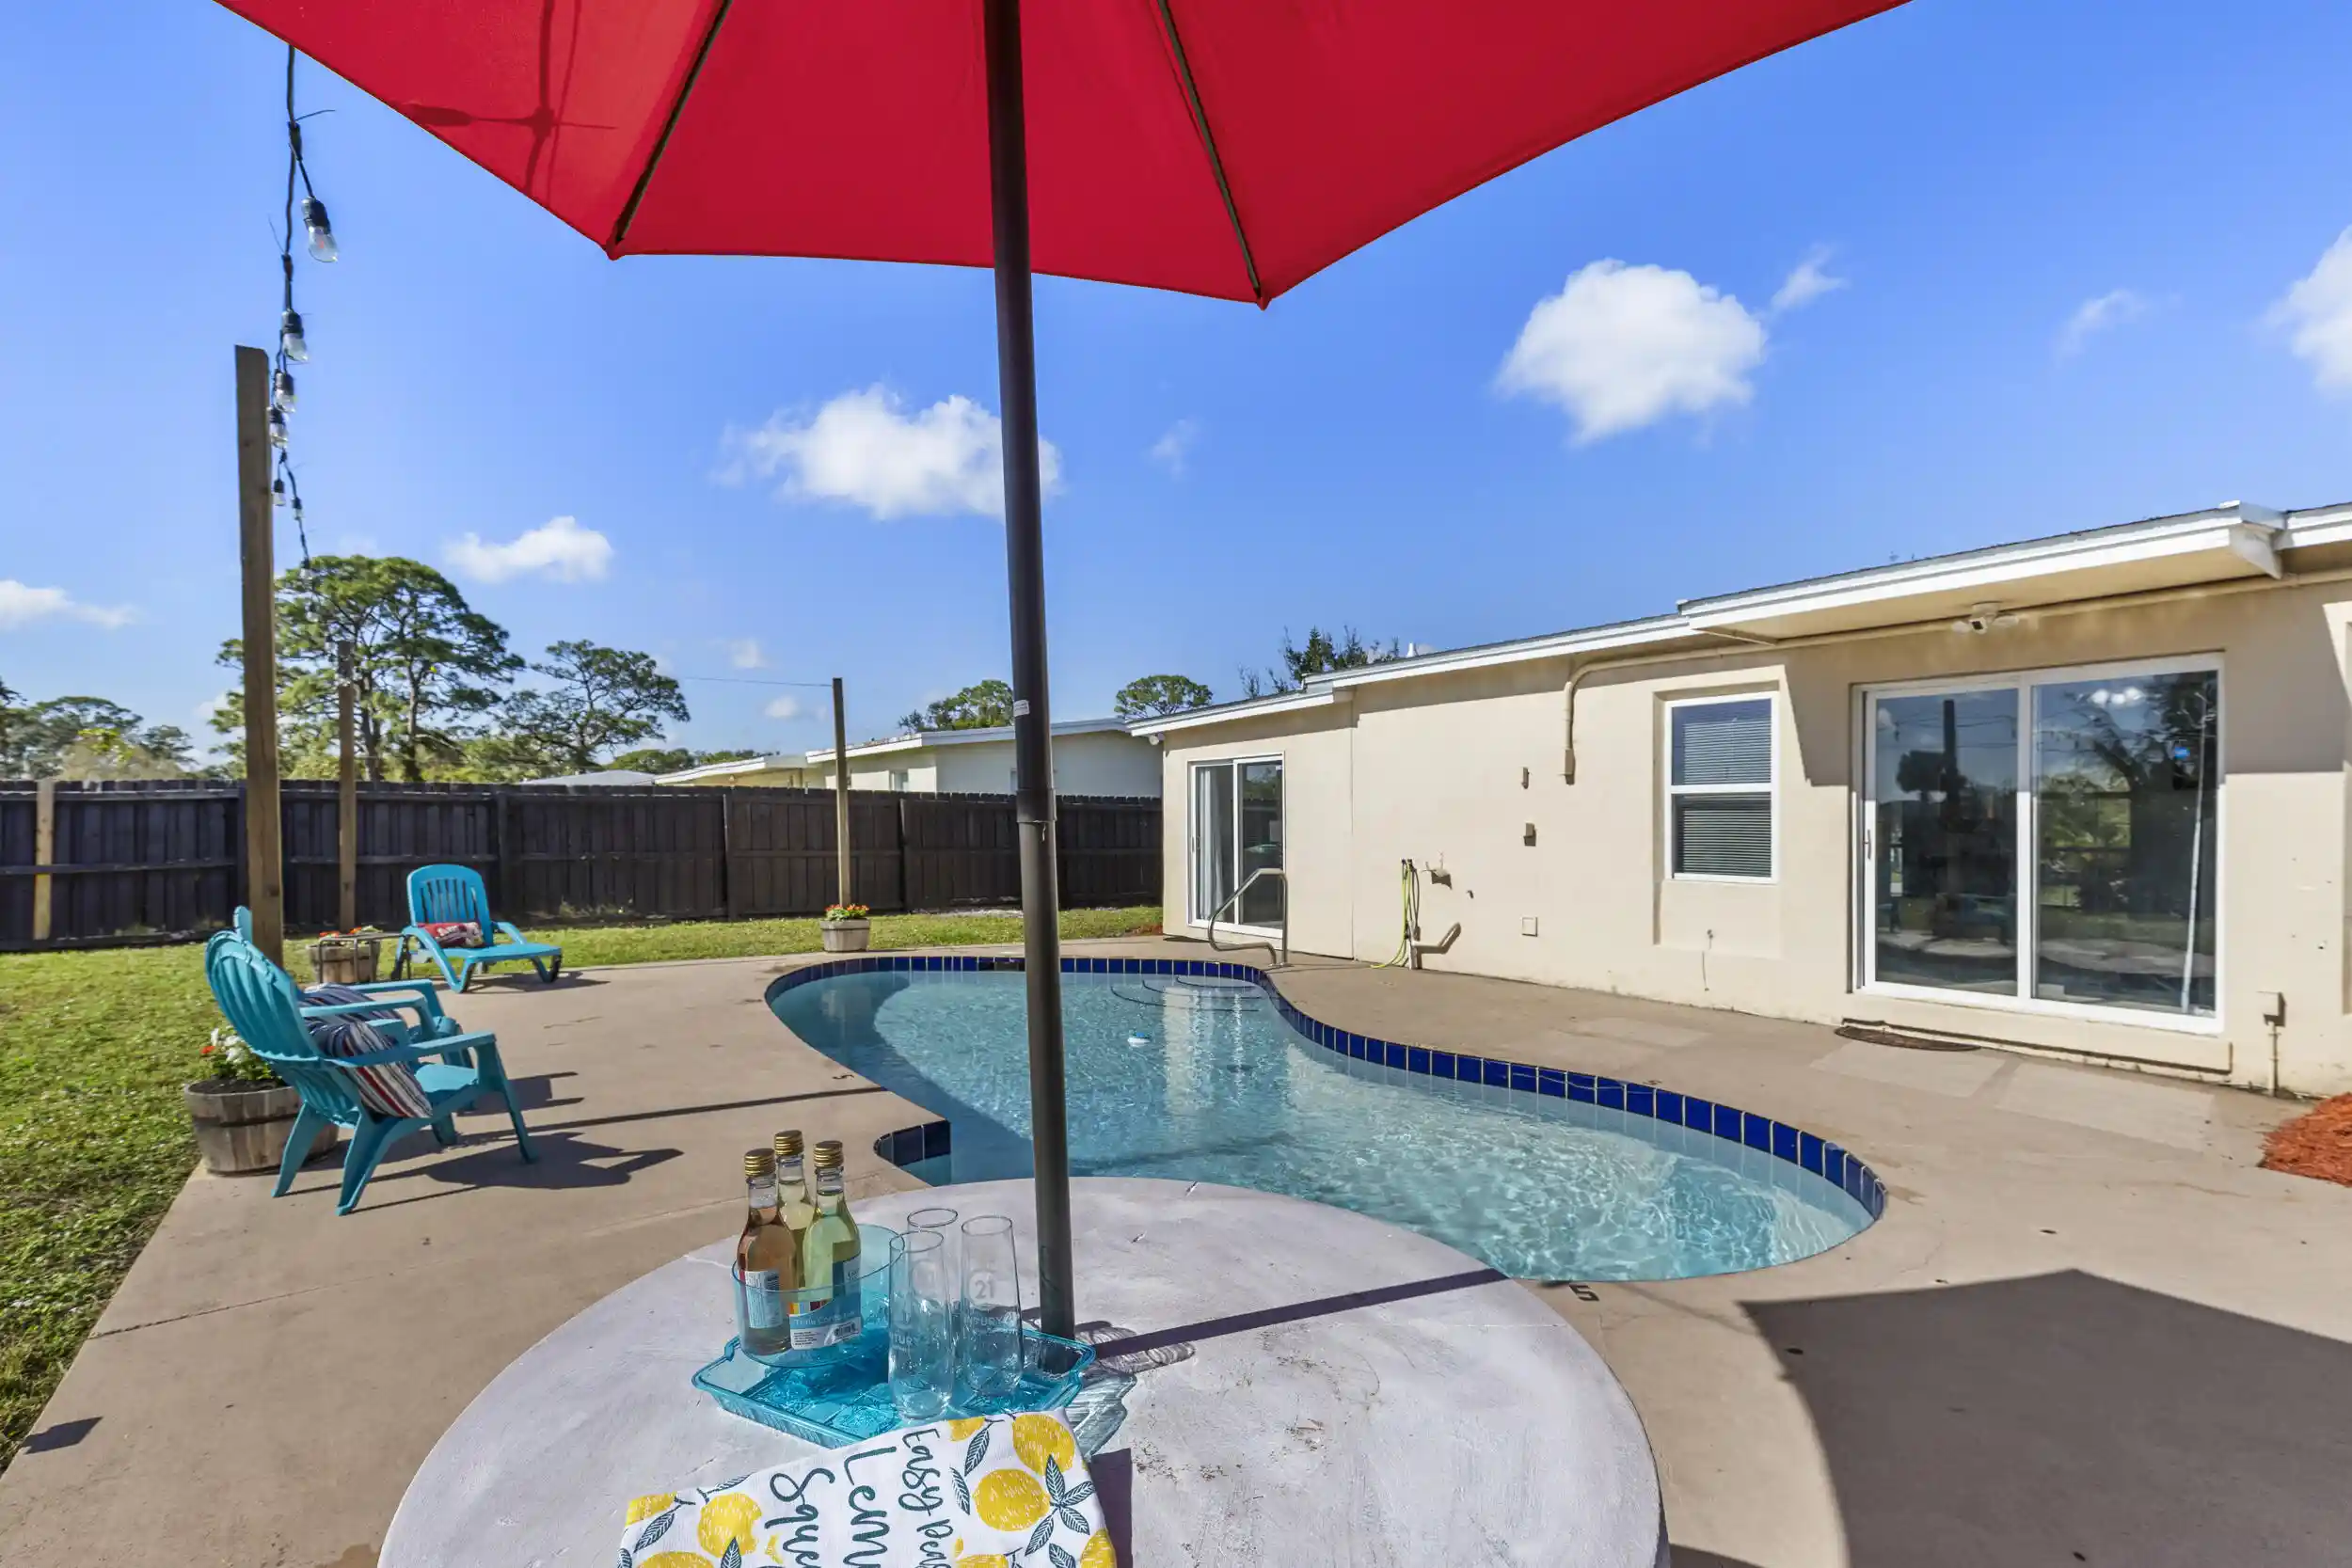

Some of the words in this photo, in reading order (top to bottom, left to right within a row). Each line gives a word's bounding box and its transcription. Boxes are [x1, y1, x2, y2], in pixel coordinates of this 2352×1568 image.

[975, 1280, 996, 1299] 21
[1569, 1284, 1599, 1301] 5
[843, 1446, 898, 1568] Lem
[898, 1428, 944, 1516] Easy
[764, 1467, 835, 1568] Sque
